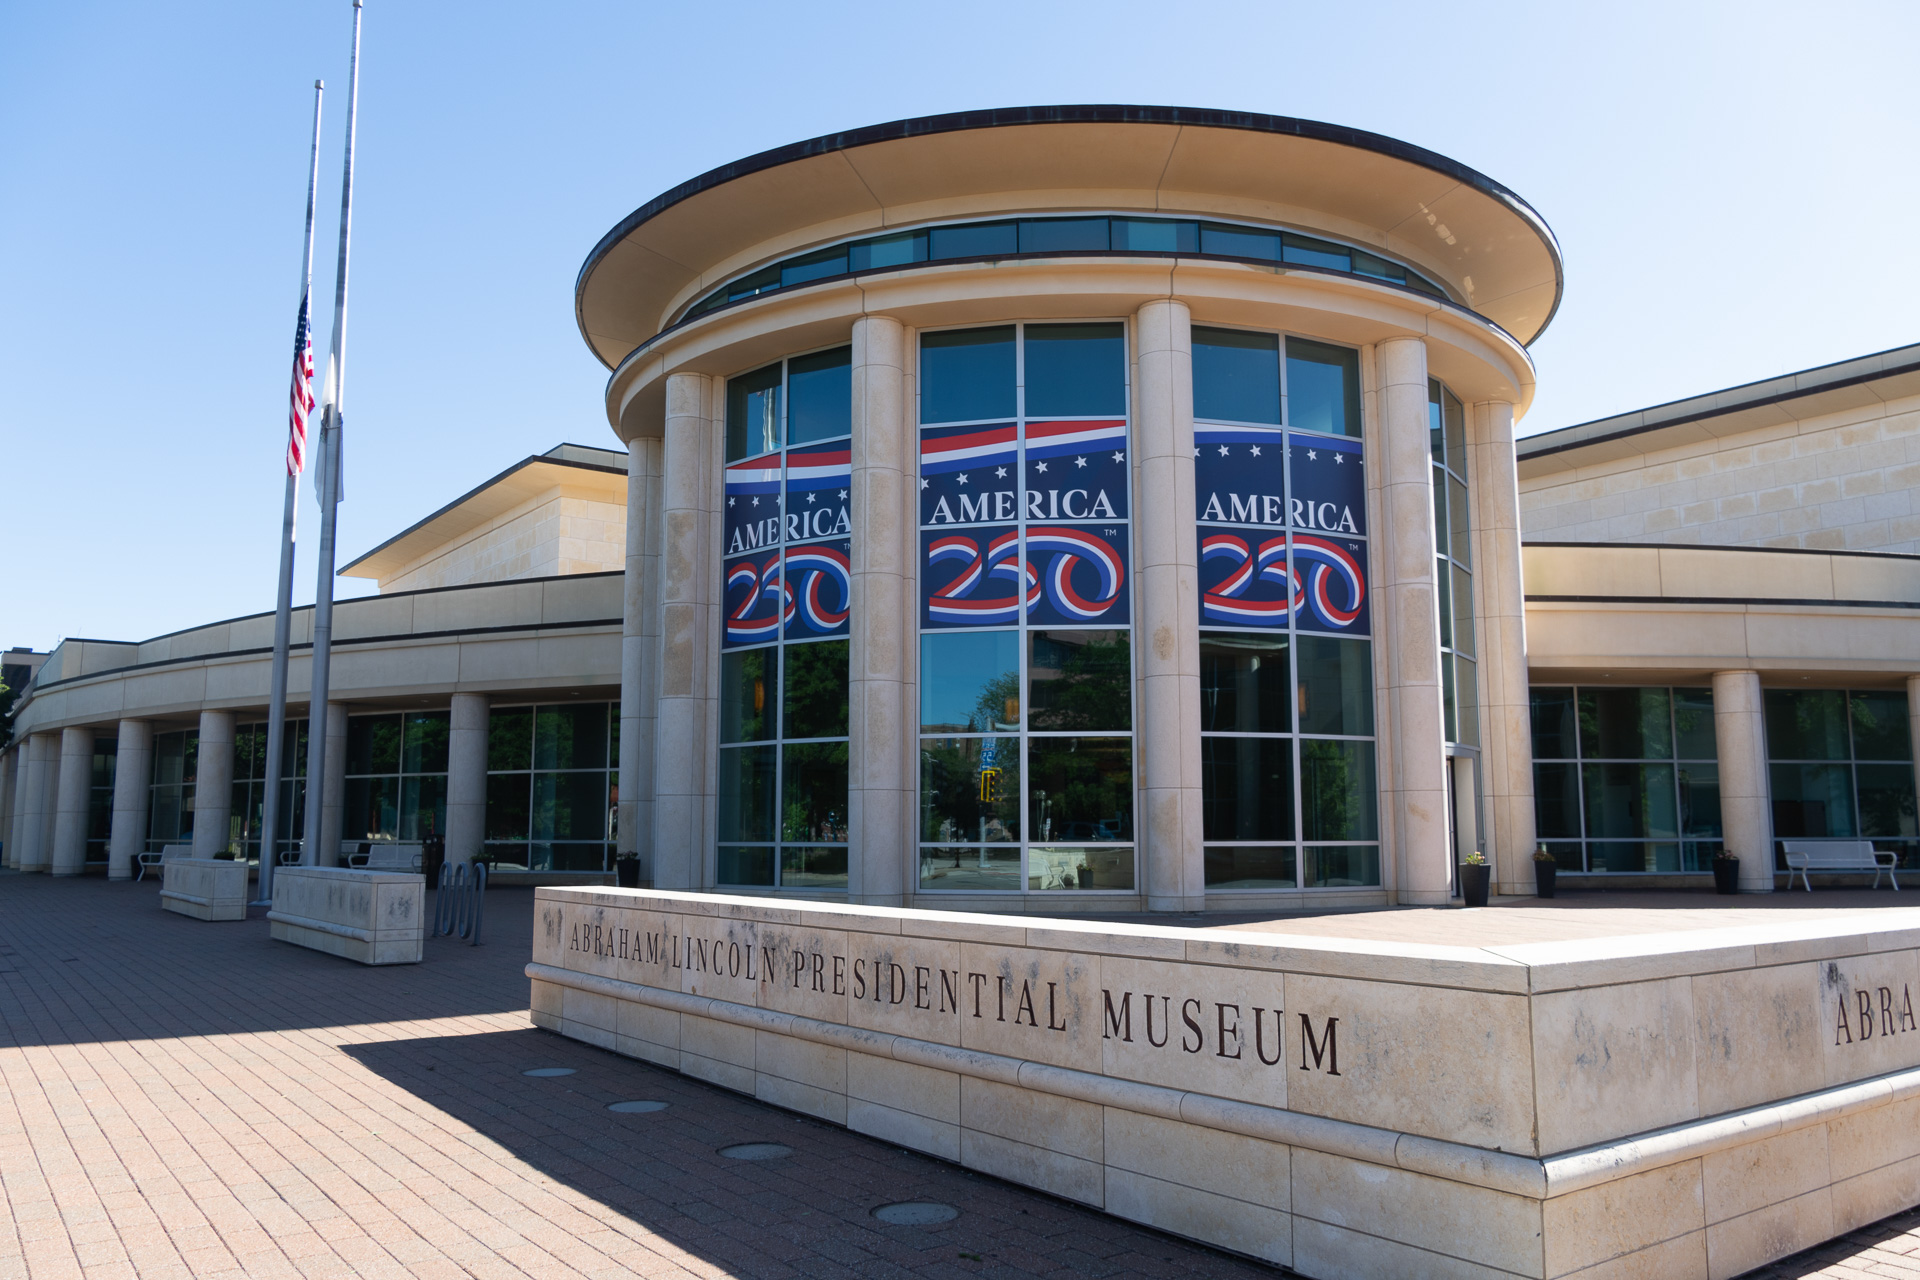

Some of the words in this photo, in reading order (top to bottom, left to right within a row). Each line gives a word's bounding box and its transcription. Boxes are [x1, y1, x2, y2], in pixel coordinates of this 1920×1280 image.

[728, 505, 851, 554] AMERICA
[928, 488, 1118, 524] AMERICA
[1104, 528, 1117, 536] TM
[1201, 491, 1359, 534] AMERICA
[1349, 543, 1359, 551] TM
[727, 545, 850, 642] 250
[928, 526, 1125, 625] 250
[1202, 534, 1365, 629] 250
[570, 922, 659, 965] ABRAHAM
[672, 935, 776, 984] LINCOLN
[793, 950, 1067, 1032] PRESIDENTIAL
[1101, 989, 1342, 1076] MUSEUM
[1834, 982, 1917, 1046] ABRA
